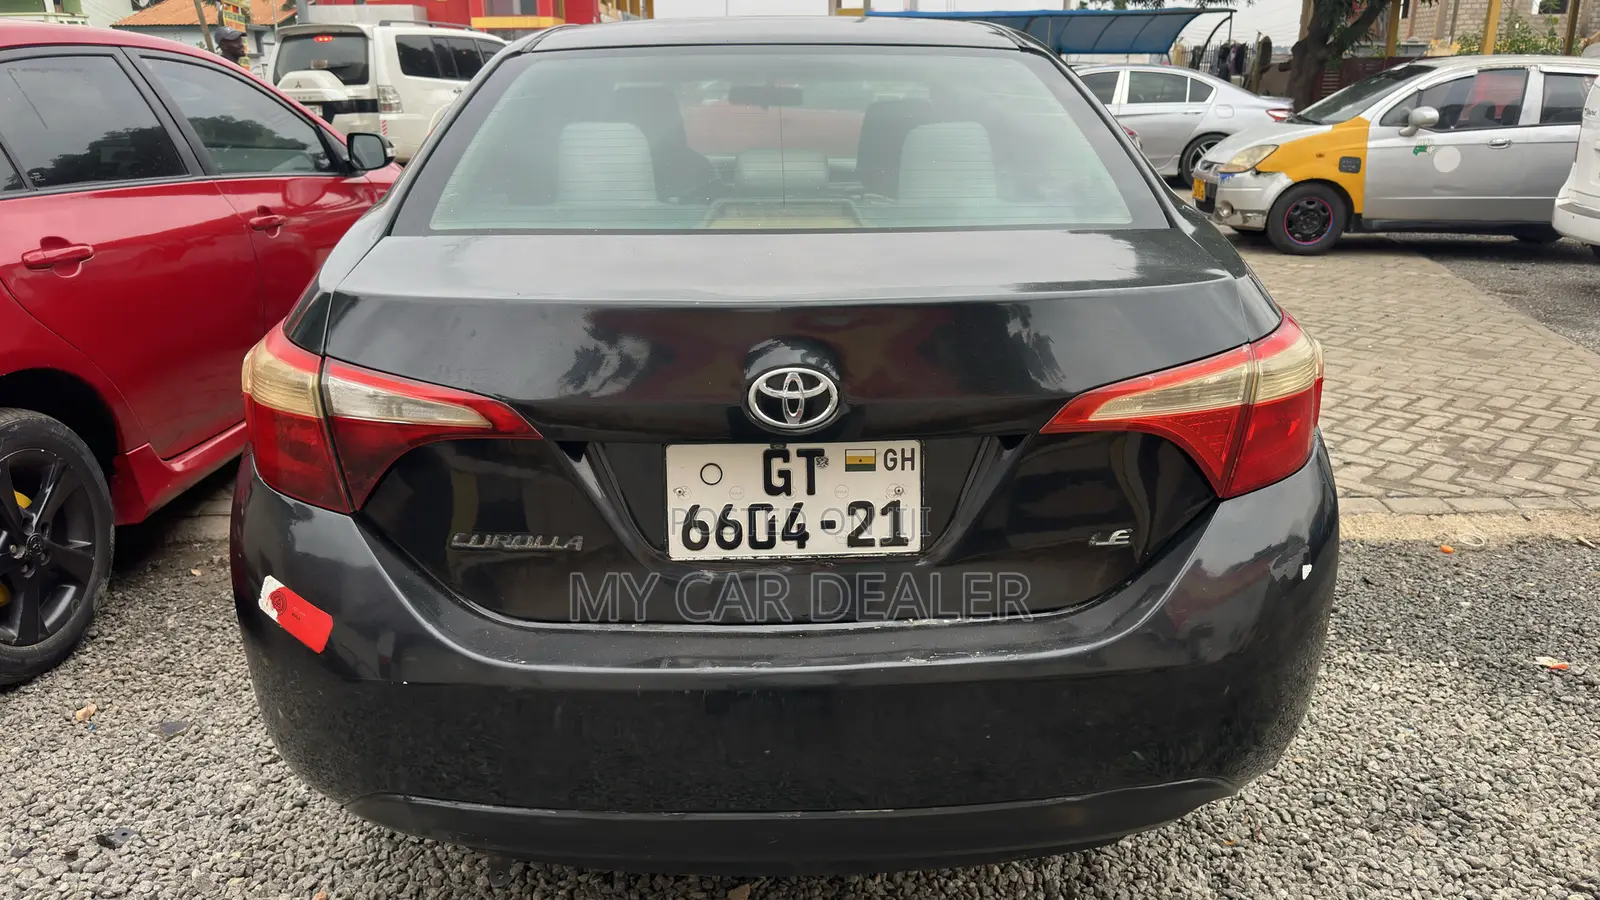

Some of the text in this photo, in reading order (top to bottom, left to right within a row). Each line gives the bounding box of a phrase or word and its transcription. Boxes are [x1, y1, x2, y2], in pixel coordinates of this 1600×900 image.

[883, 448, 915, 471] GH
[763, 448, 824, 496] GT
[681, 500, 908, 550] 6604-21
[451, 532, 584, 551] COROLLA
[1089, 528, 1133, 546] LE
